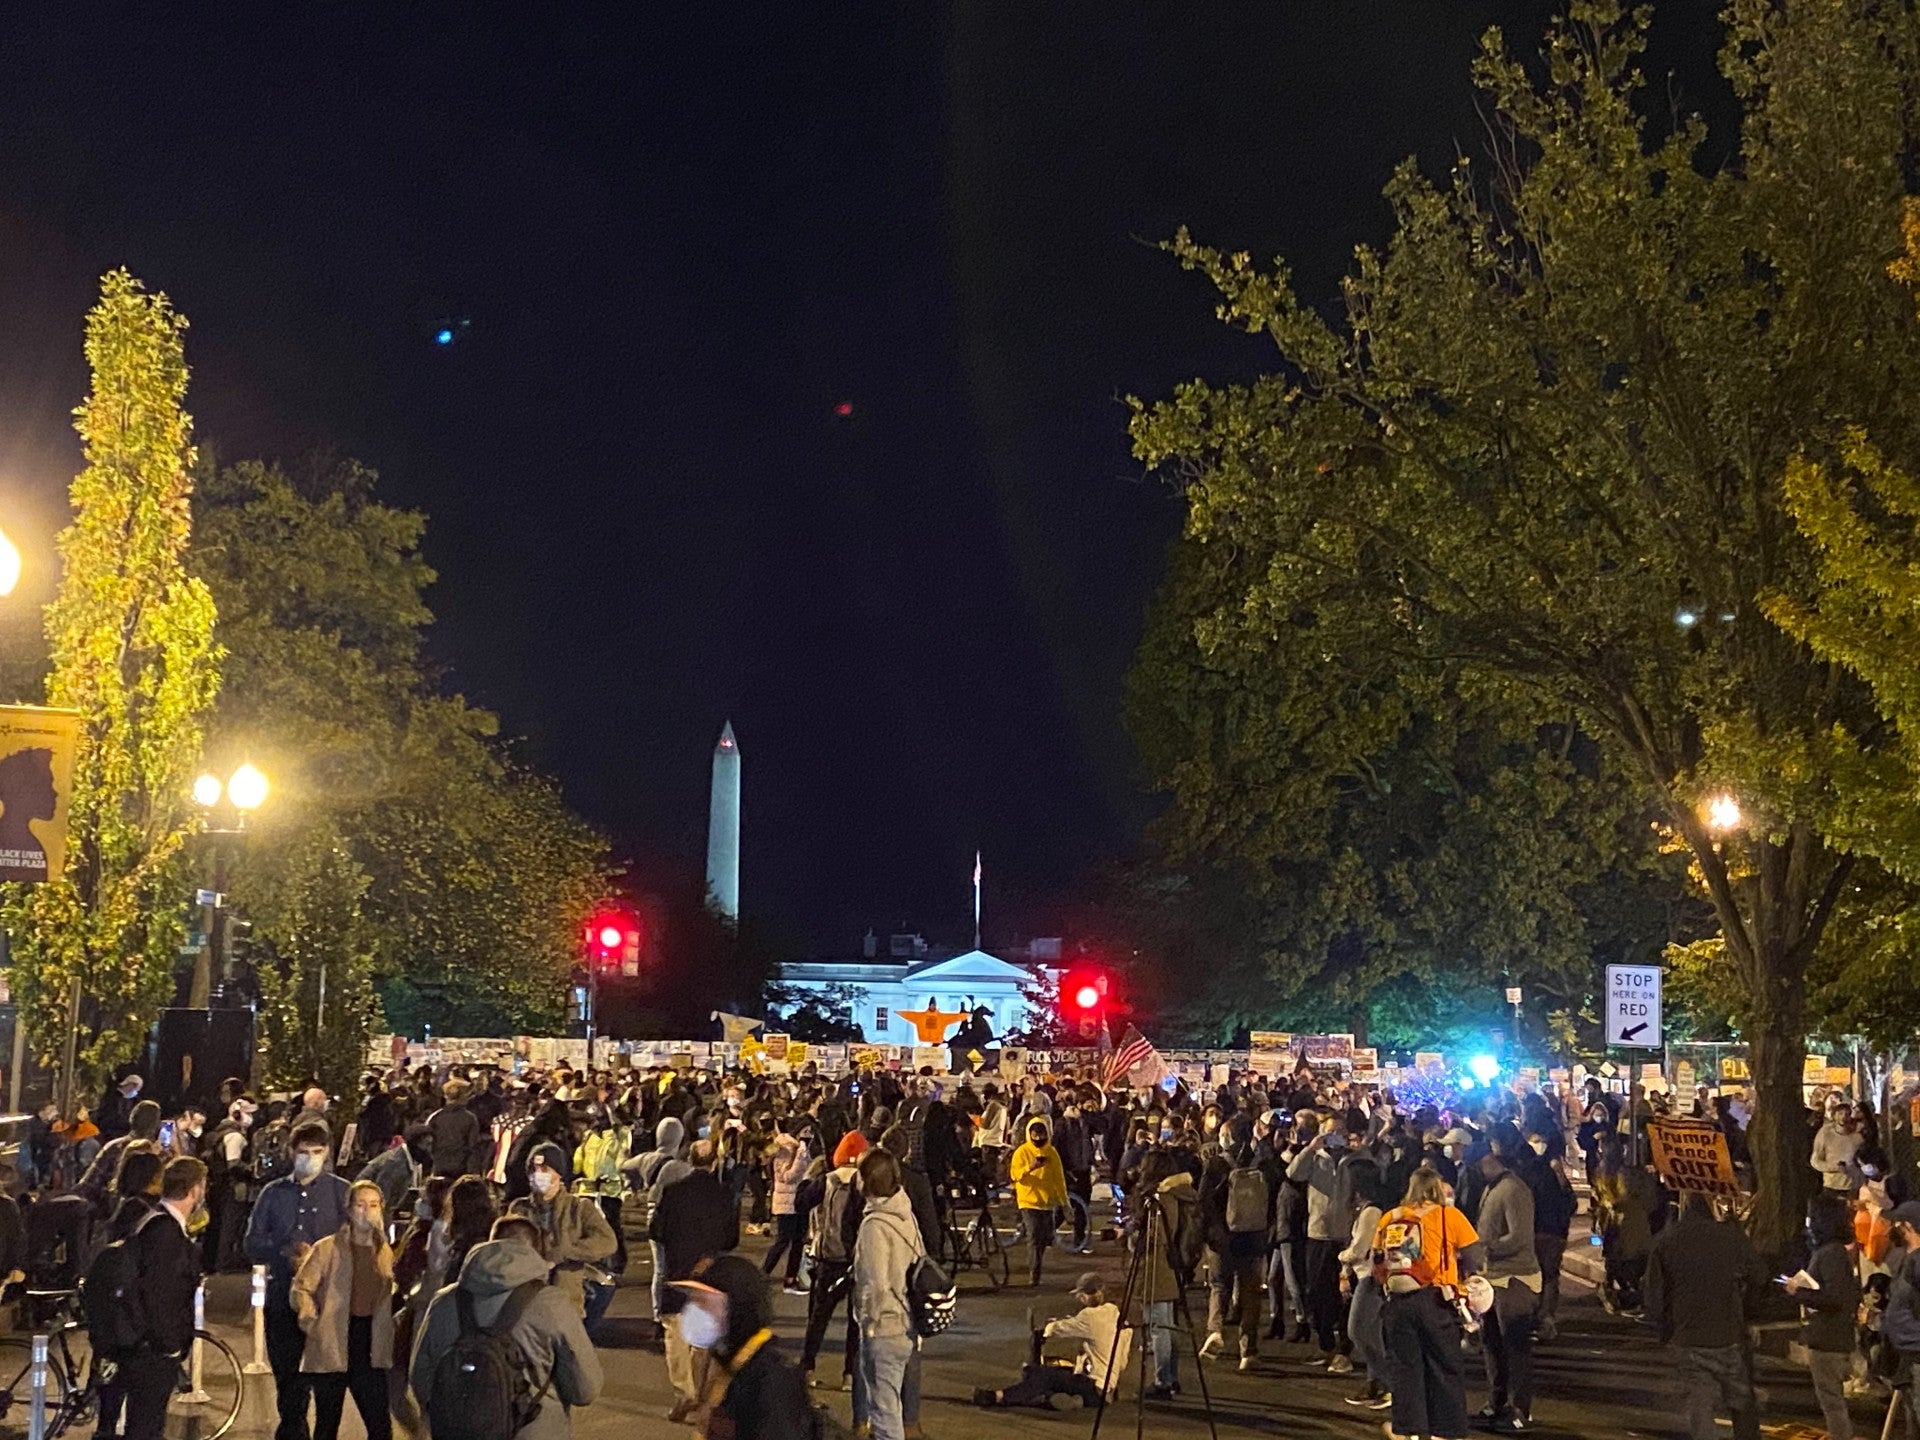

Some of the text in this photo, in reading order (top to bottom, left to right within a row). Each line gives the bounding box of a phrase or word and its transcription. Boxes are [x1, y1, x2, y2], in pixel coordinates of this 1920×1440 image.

[0, 849, 44, 860] LACK LIVES
[0, 859, 47, 869] ATTER PLAZA
[1615, 973, 1652, 987] STOP
[1612, 990, 1655, 1000] HERE ON
[1620, 1003, 1648, 1016] RED
[1027, 1050, 1051, 1063] FUCK
[1026, 1063, 1051, 1075] YOUR
[1663, 1142, 1717, 1160] Pence
[1670, 1158, 1719, 1179] OUT
